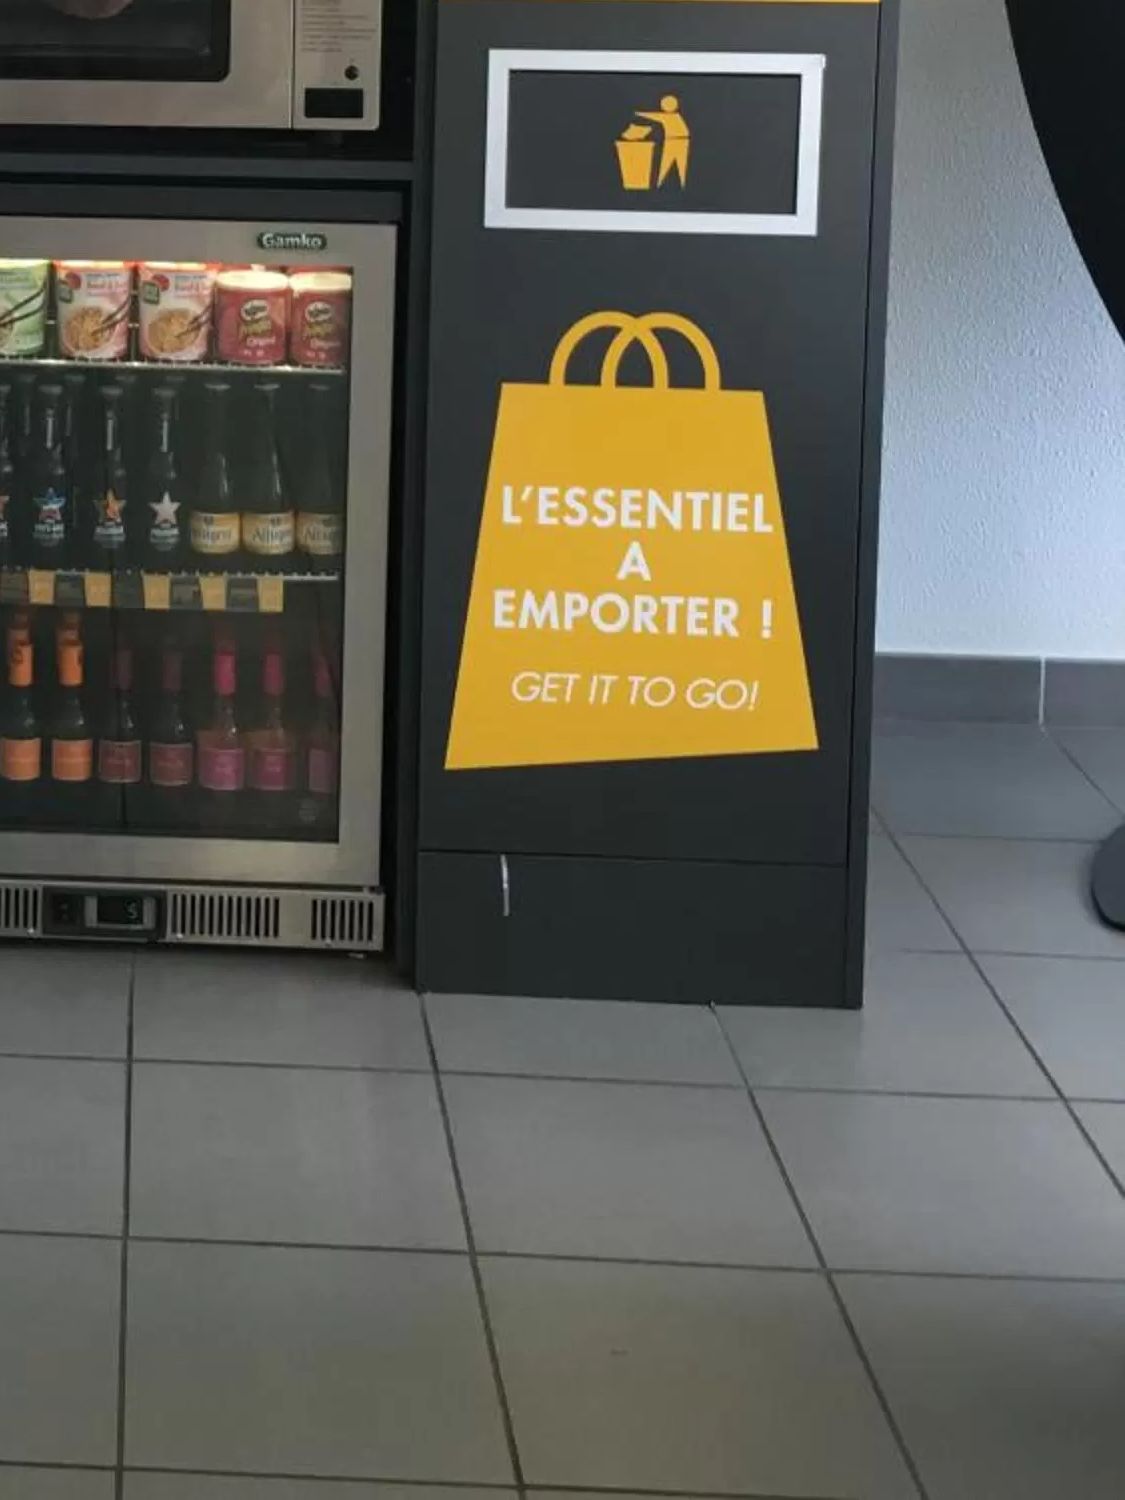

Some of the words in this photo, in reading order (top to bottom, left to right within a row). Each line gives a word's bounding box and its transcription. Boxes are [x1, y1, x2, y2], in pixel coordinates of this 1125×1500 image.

[262, 232, 323, 249] Gamko
[502, 485, 774, 533] L'ESSENTIEL
[616, 540, 652, 581] A
[493, 588, 740, 638] EMPORTER
[761, 601, 773, 639] !
[511, 671, 581, 704] GET
[589, 675, 619, 706] IT
[628, 675, 676, 708] TO
[686, 678, 760, 711] GO!
